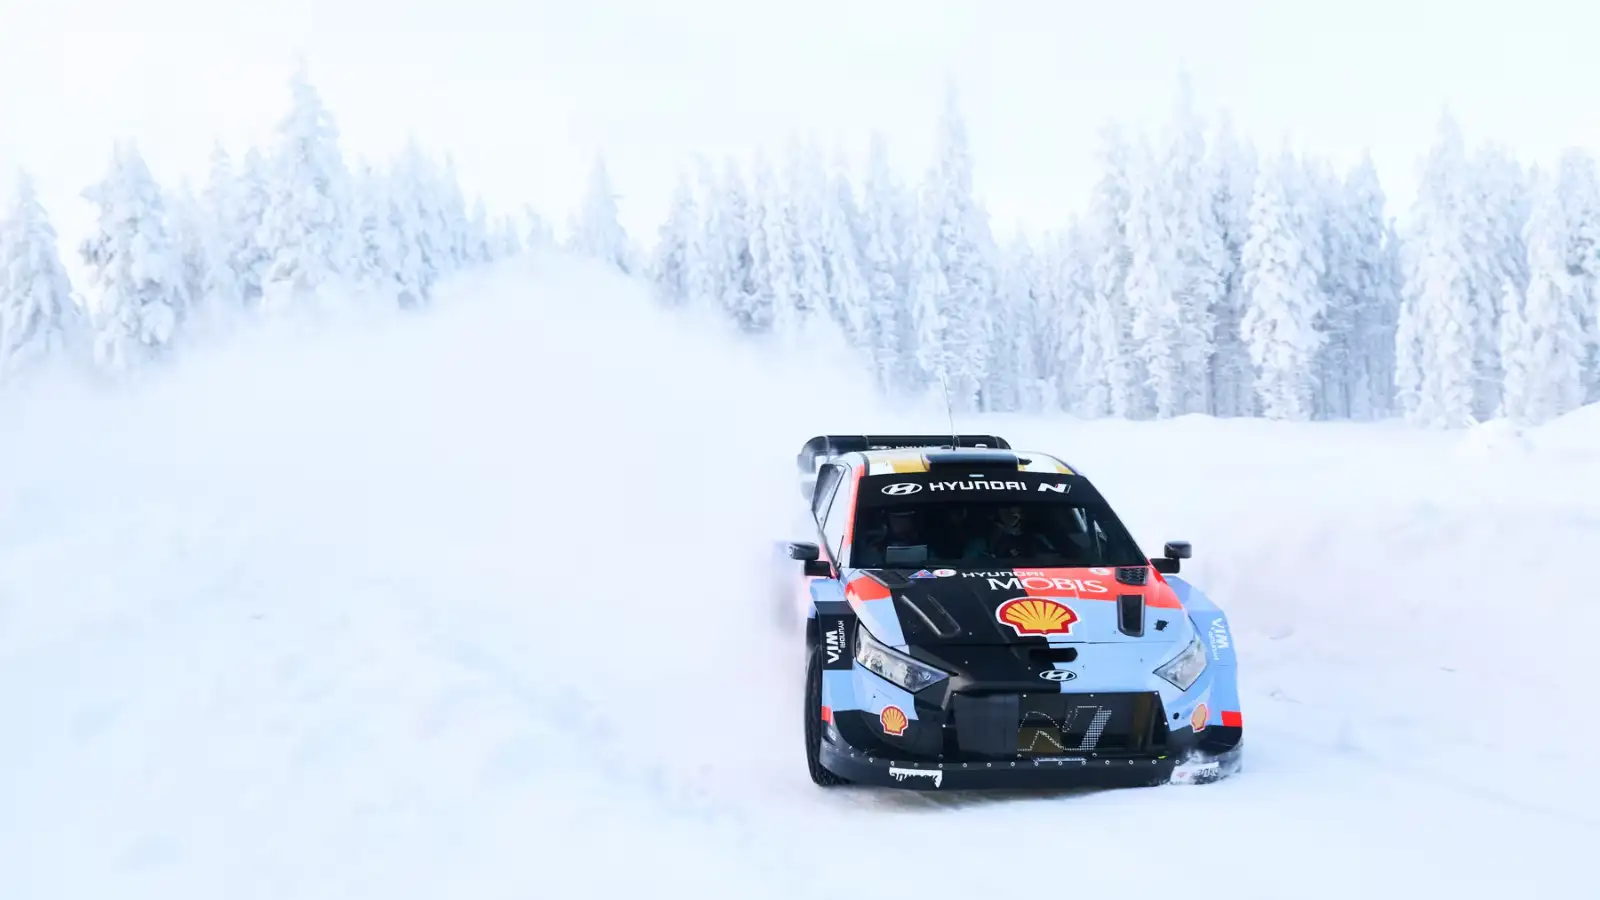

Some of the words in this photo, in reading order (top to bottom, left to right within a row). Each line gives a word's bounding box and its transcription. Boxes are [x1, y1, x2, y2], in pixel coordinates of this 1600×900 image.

[929, 481, 1027, 491] HYUNDAI
[987, 577, 1108, 593] MOBIS
[838, 620, 846, 648] HYUNDAI
[826, 630, 841, 664] WIA
